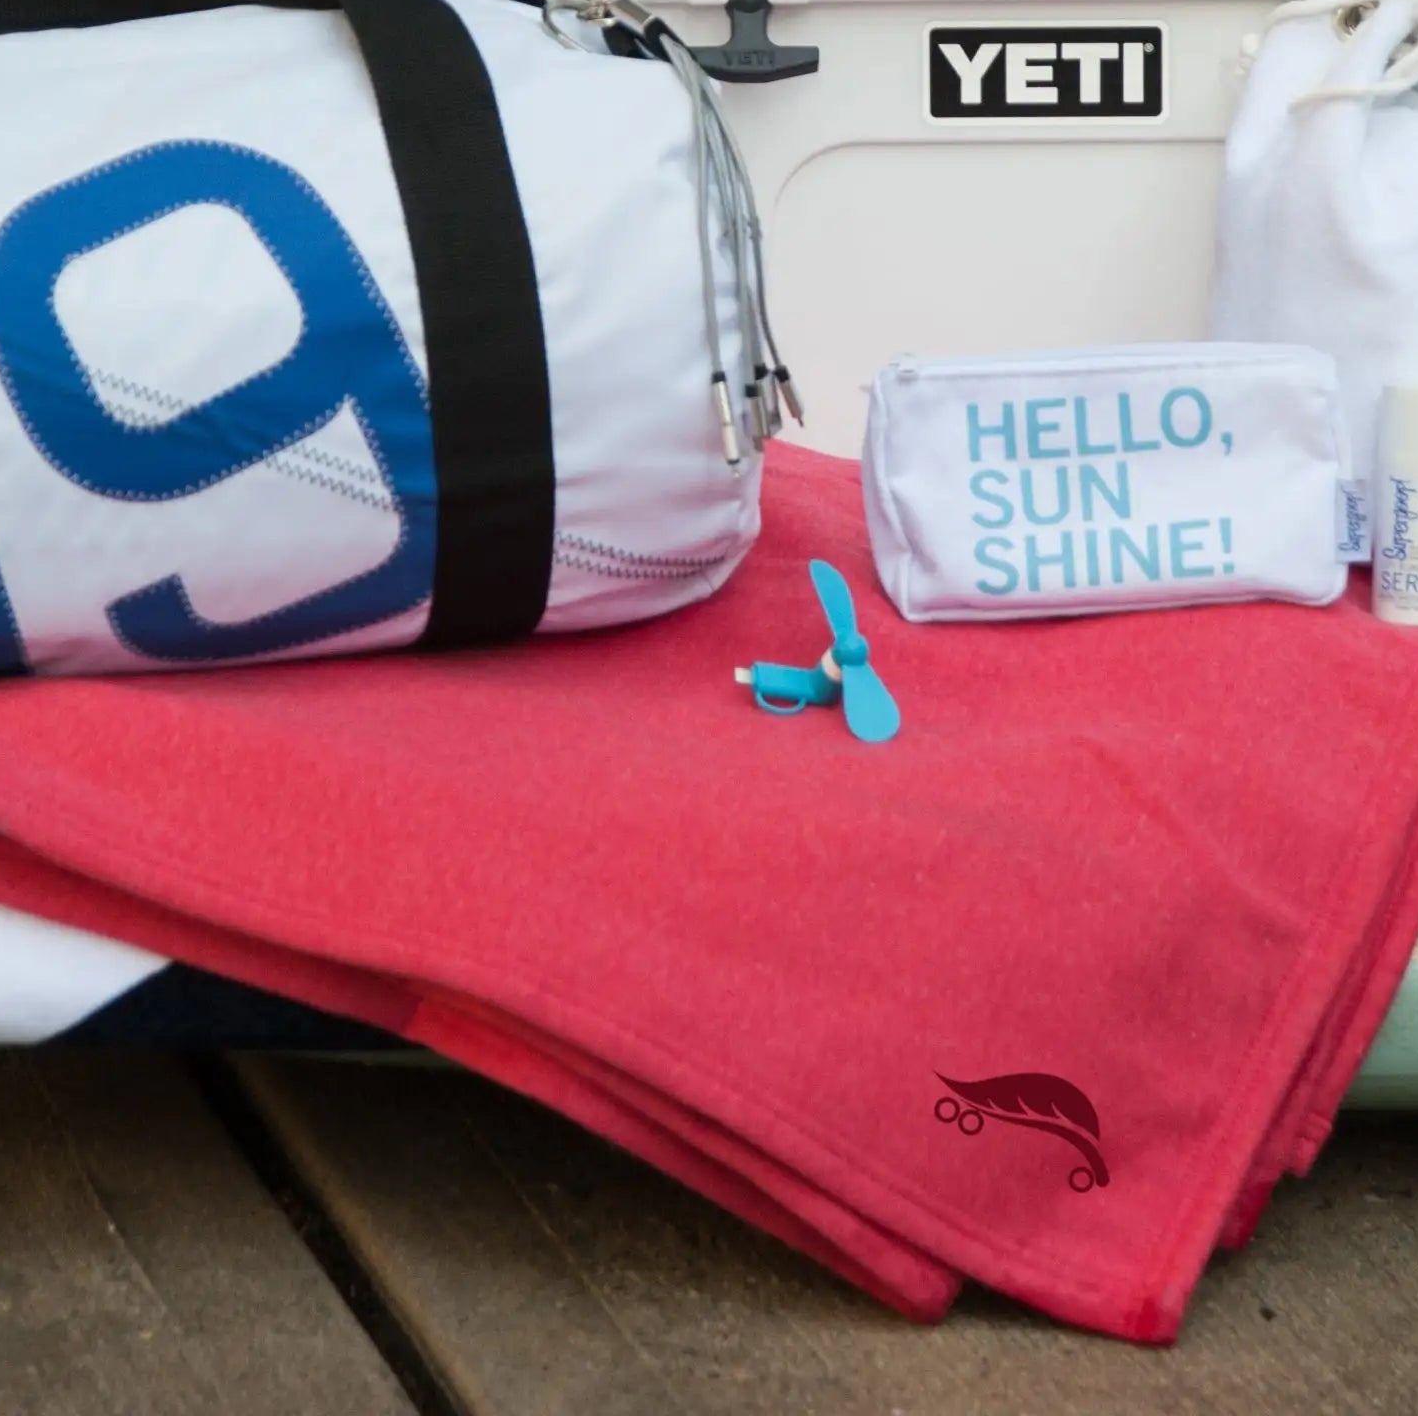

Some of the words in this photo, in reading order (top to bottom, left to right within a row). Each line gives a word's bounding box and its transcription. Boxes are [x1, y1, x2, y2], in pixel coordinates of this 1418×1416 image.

[721, 49, 776, 66] YETI
[937, 41, 1146, 105] YETI
[966, 386, 1233, 463] HELLO,
[969, 460, 1132, 530] SUN
[973, 516, 1236, 596] SHINE!
